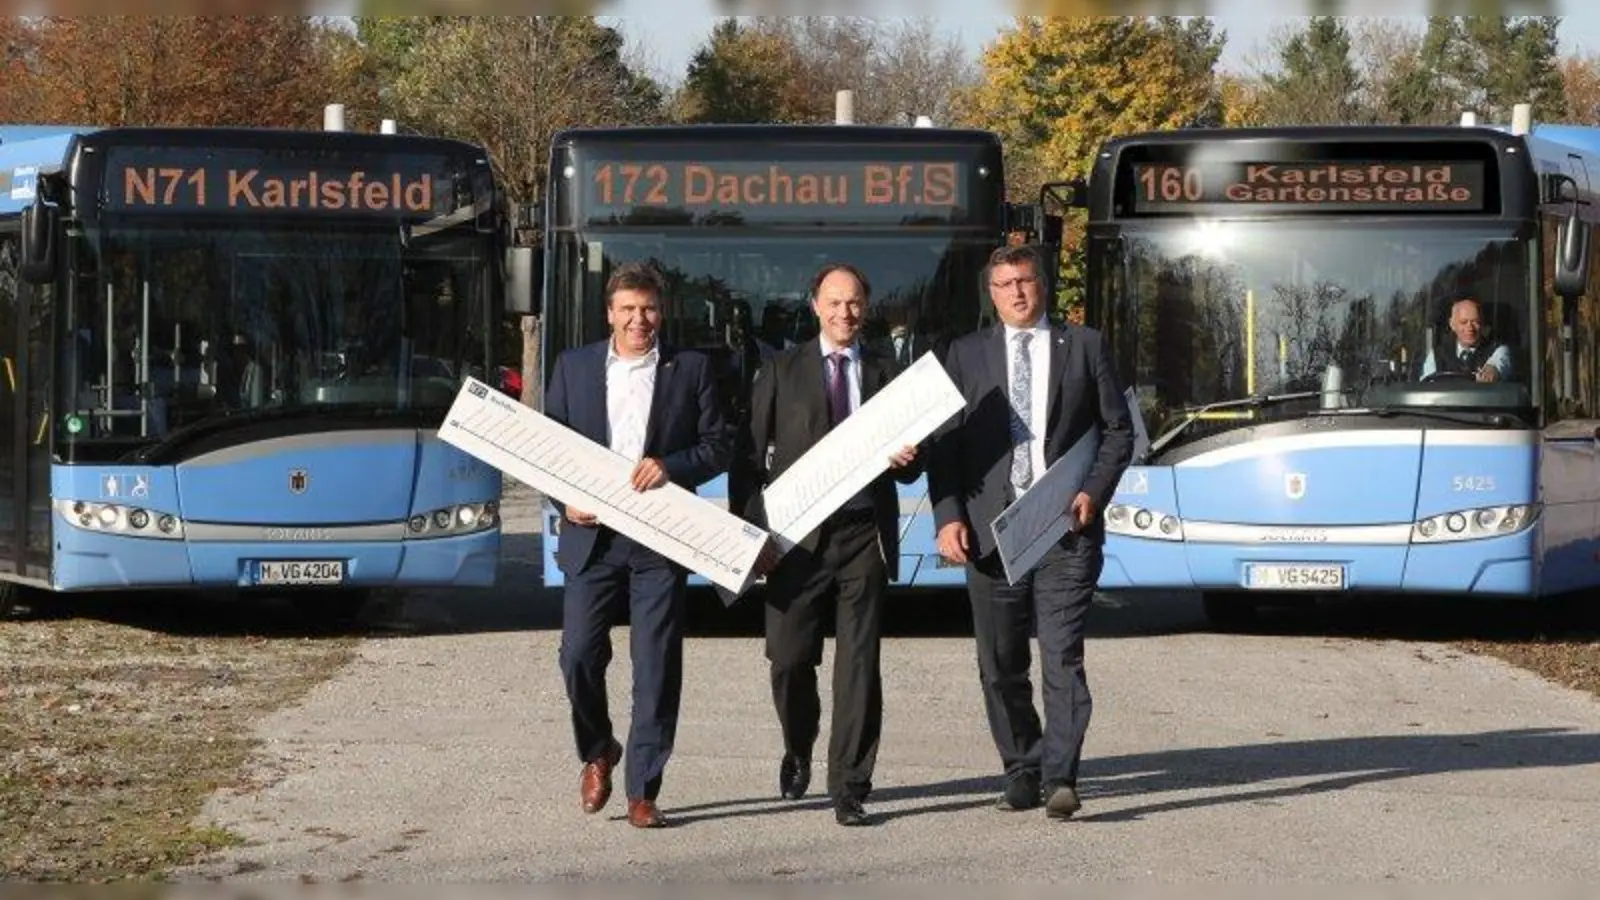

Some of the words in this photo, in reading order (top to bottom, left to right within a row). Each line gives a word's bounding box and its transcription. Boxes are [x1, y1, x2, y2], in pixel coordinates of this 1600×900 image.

[125, 167, 206, 205] N71
[228, 169, 432, 210] Karlsfeld
[594, 164, 668, 204] 172
[685, 164, 848, 205] Dachau
[1140, 166, 1203, 200] 160
[1247, 165, 1450, 183] Karlsfeld
[1225, 183, 1471, 201] Gartenstraße
